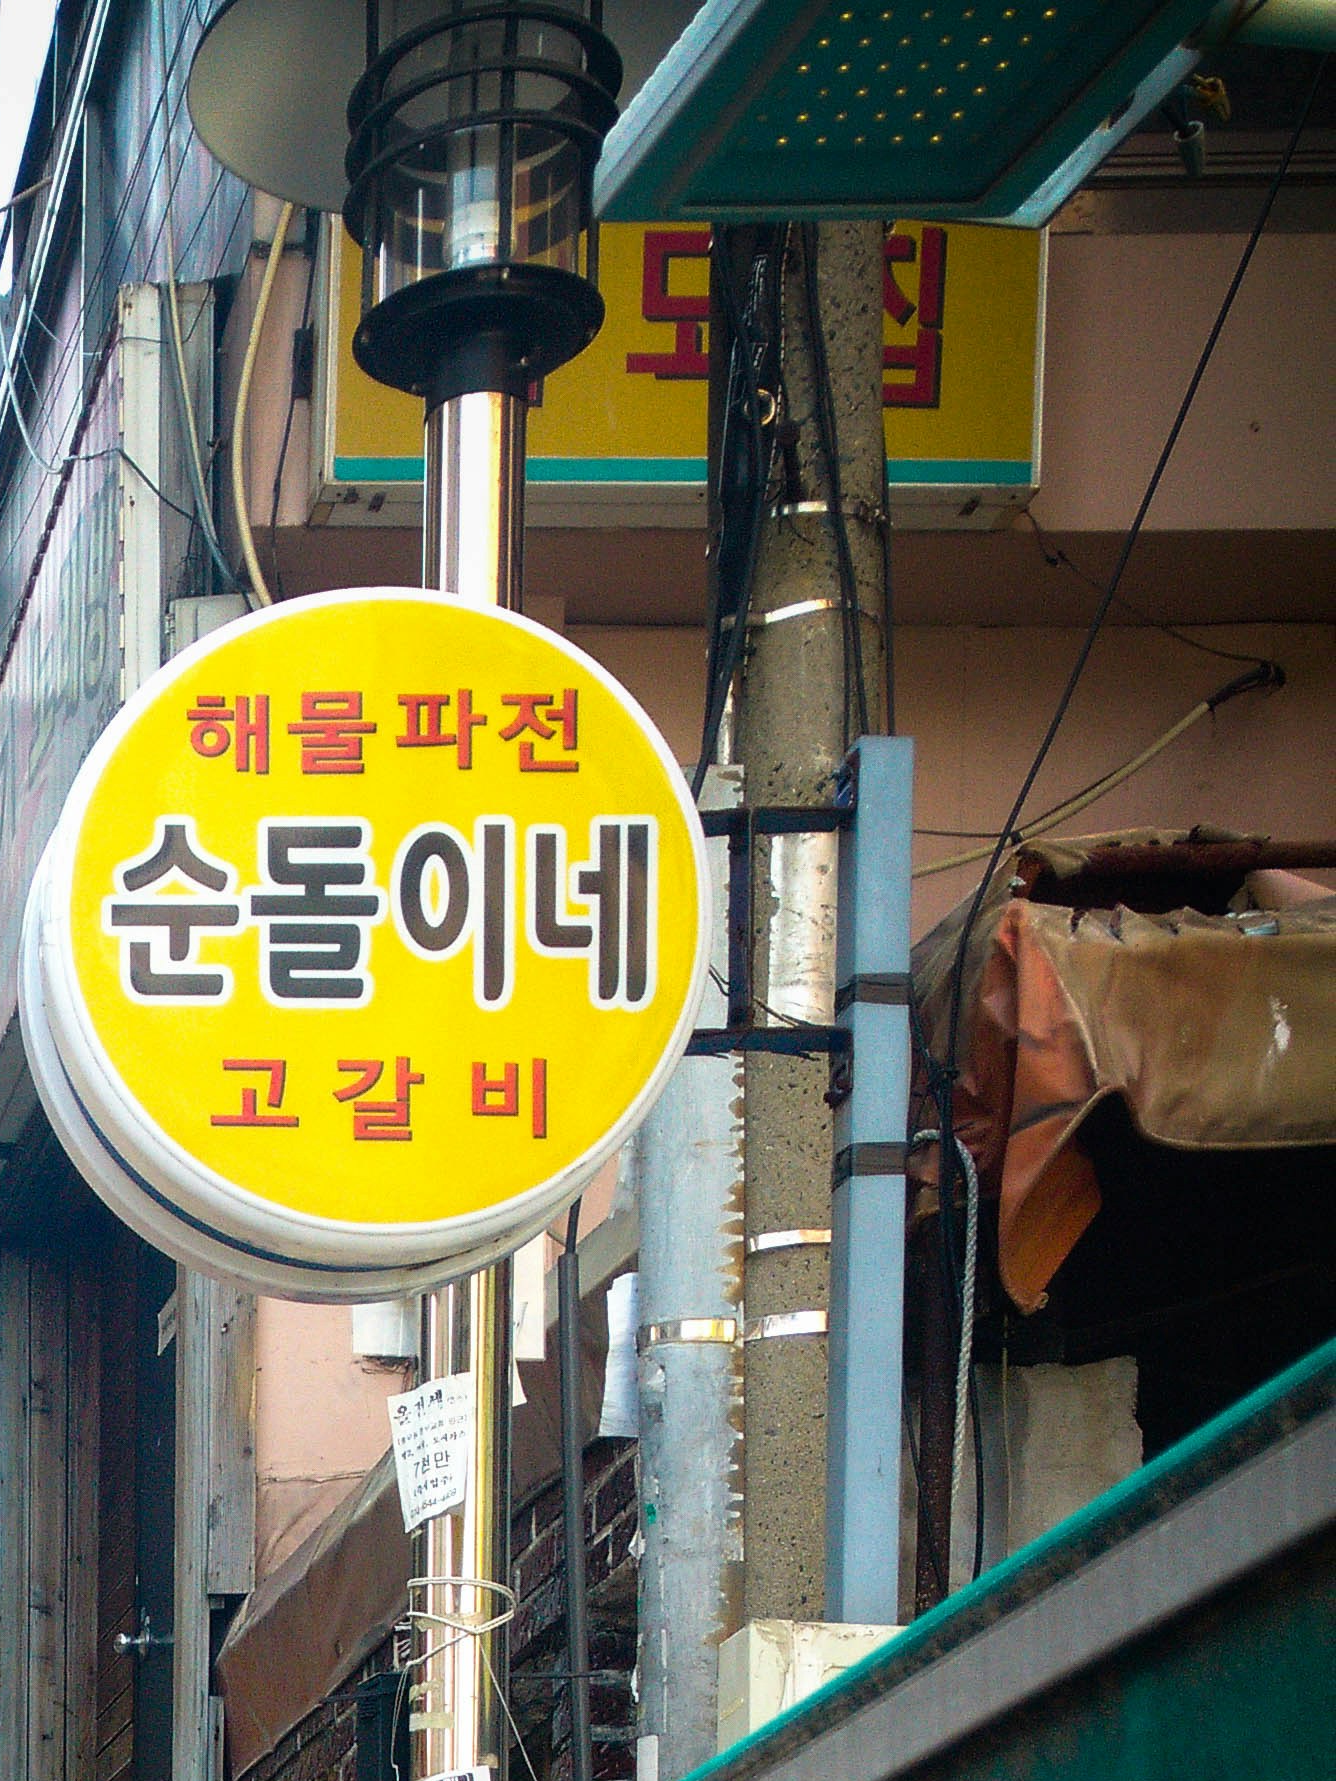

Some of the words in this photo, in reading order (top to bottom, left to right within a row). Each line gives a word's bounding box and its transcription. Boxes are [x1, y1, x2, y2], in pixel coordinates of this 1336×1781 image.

[186, 688, 580, 775] 해물파전
[107, 817, 655, 1008] 순돌이네
[210, 1055, 550, 1141] 고갈비
